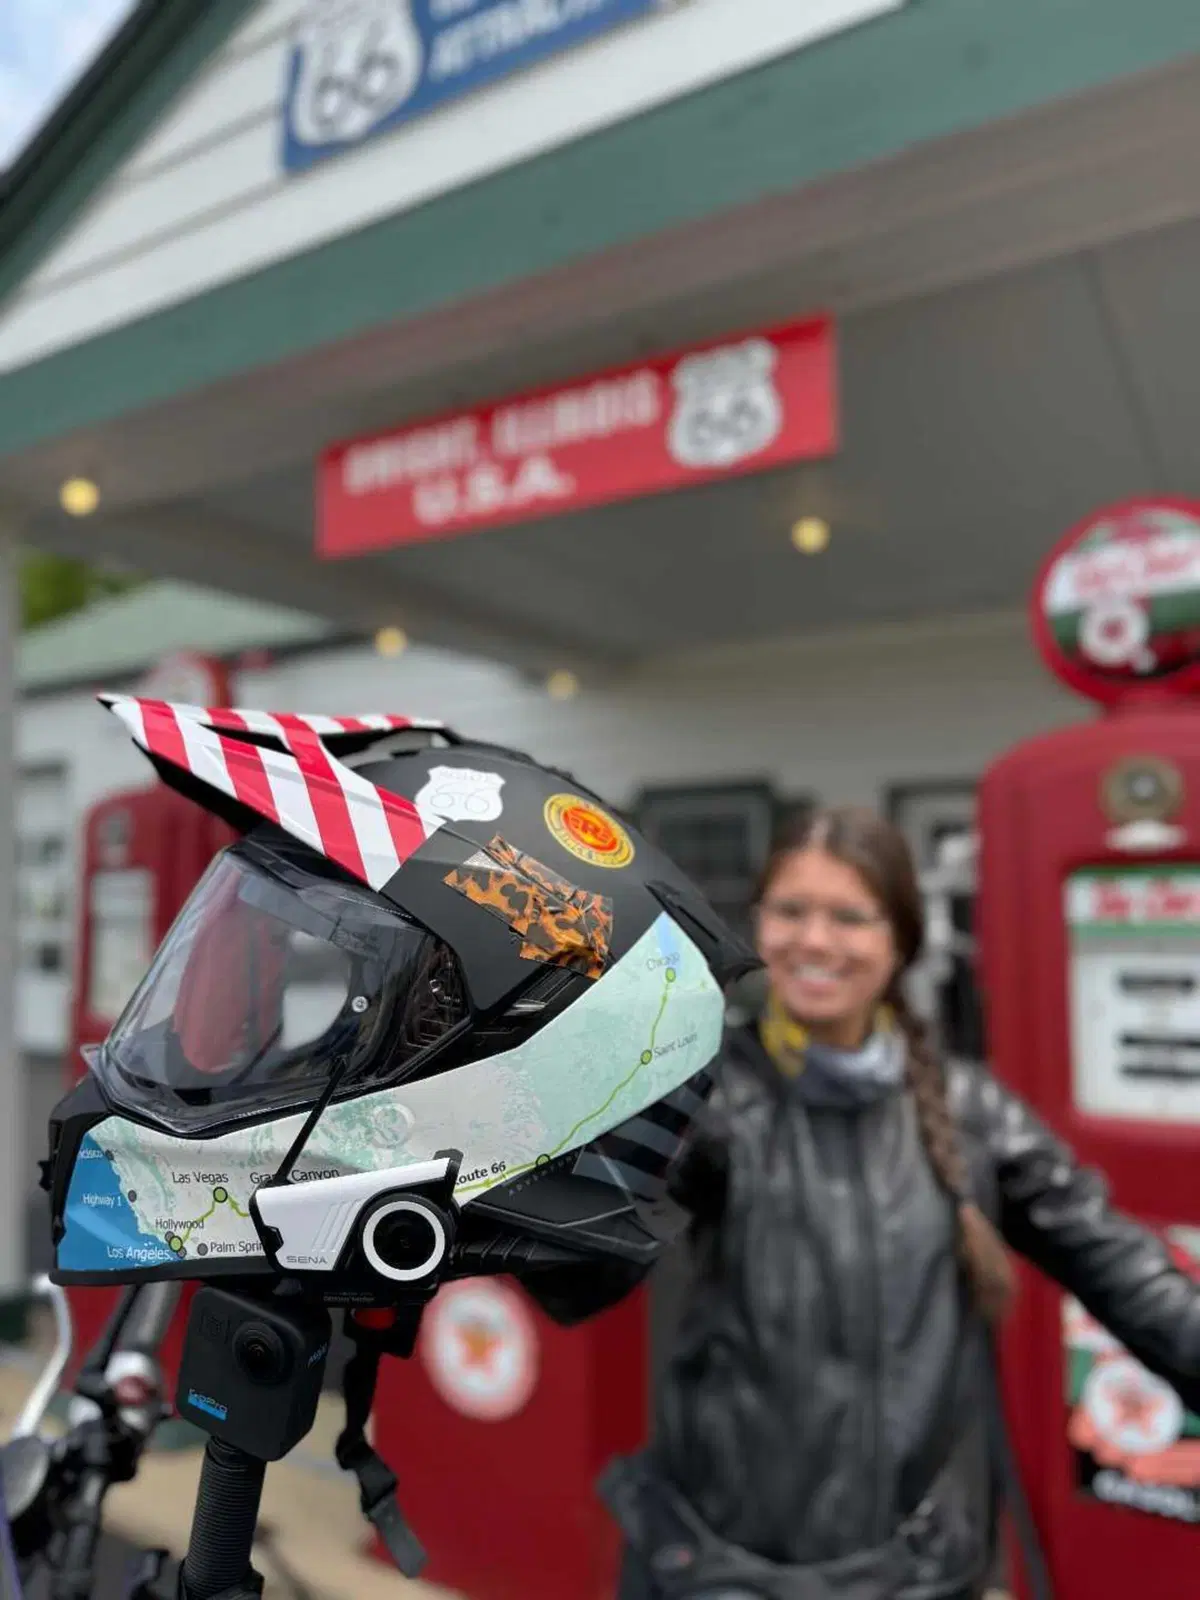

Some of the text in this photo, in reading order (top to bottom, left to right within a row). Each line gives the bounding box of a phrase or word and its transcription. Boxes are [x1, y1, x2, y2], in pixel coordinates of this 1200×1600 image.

[171, 1170, 229, 1186] Las Vegas
[249, 1168, 341, 1185] Gra Canyon
[456, 1160, 507, 1186] oute 66
[82, 1192, 115, 1209] Highway
[155, 1218, 205, 1232] Hollywood
[106, 1245, 125, 1259] Los
[210, 1239, 264, 1254] Palm Sprin
[285, 1254, 329, 1265] SENA
